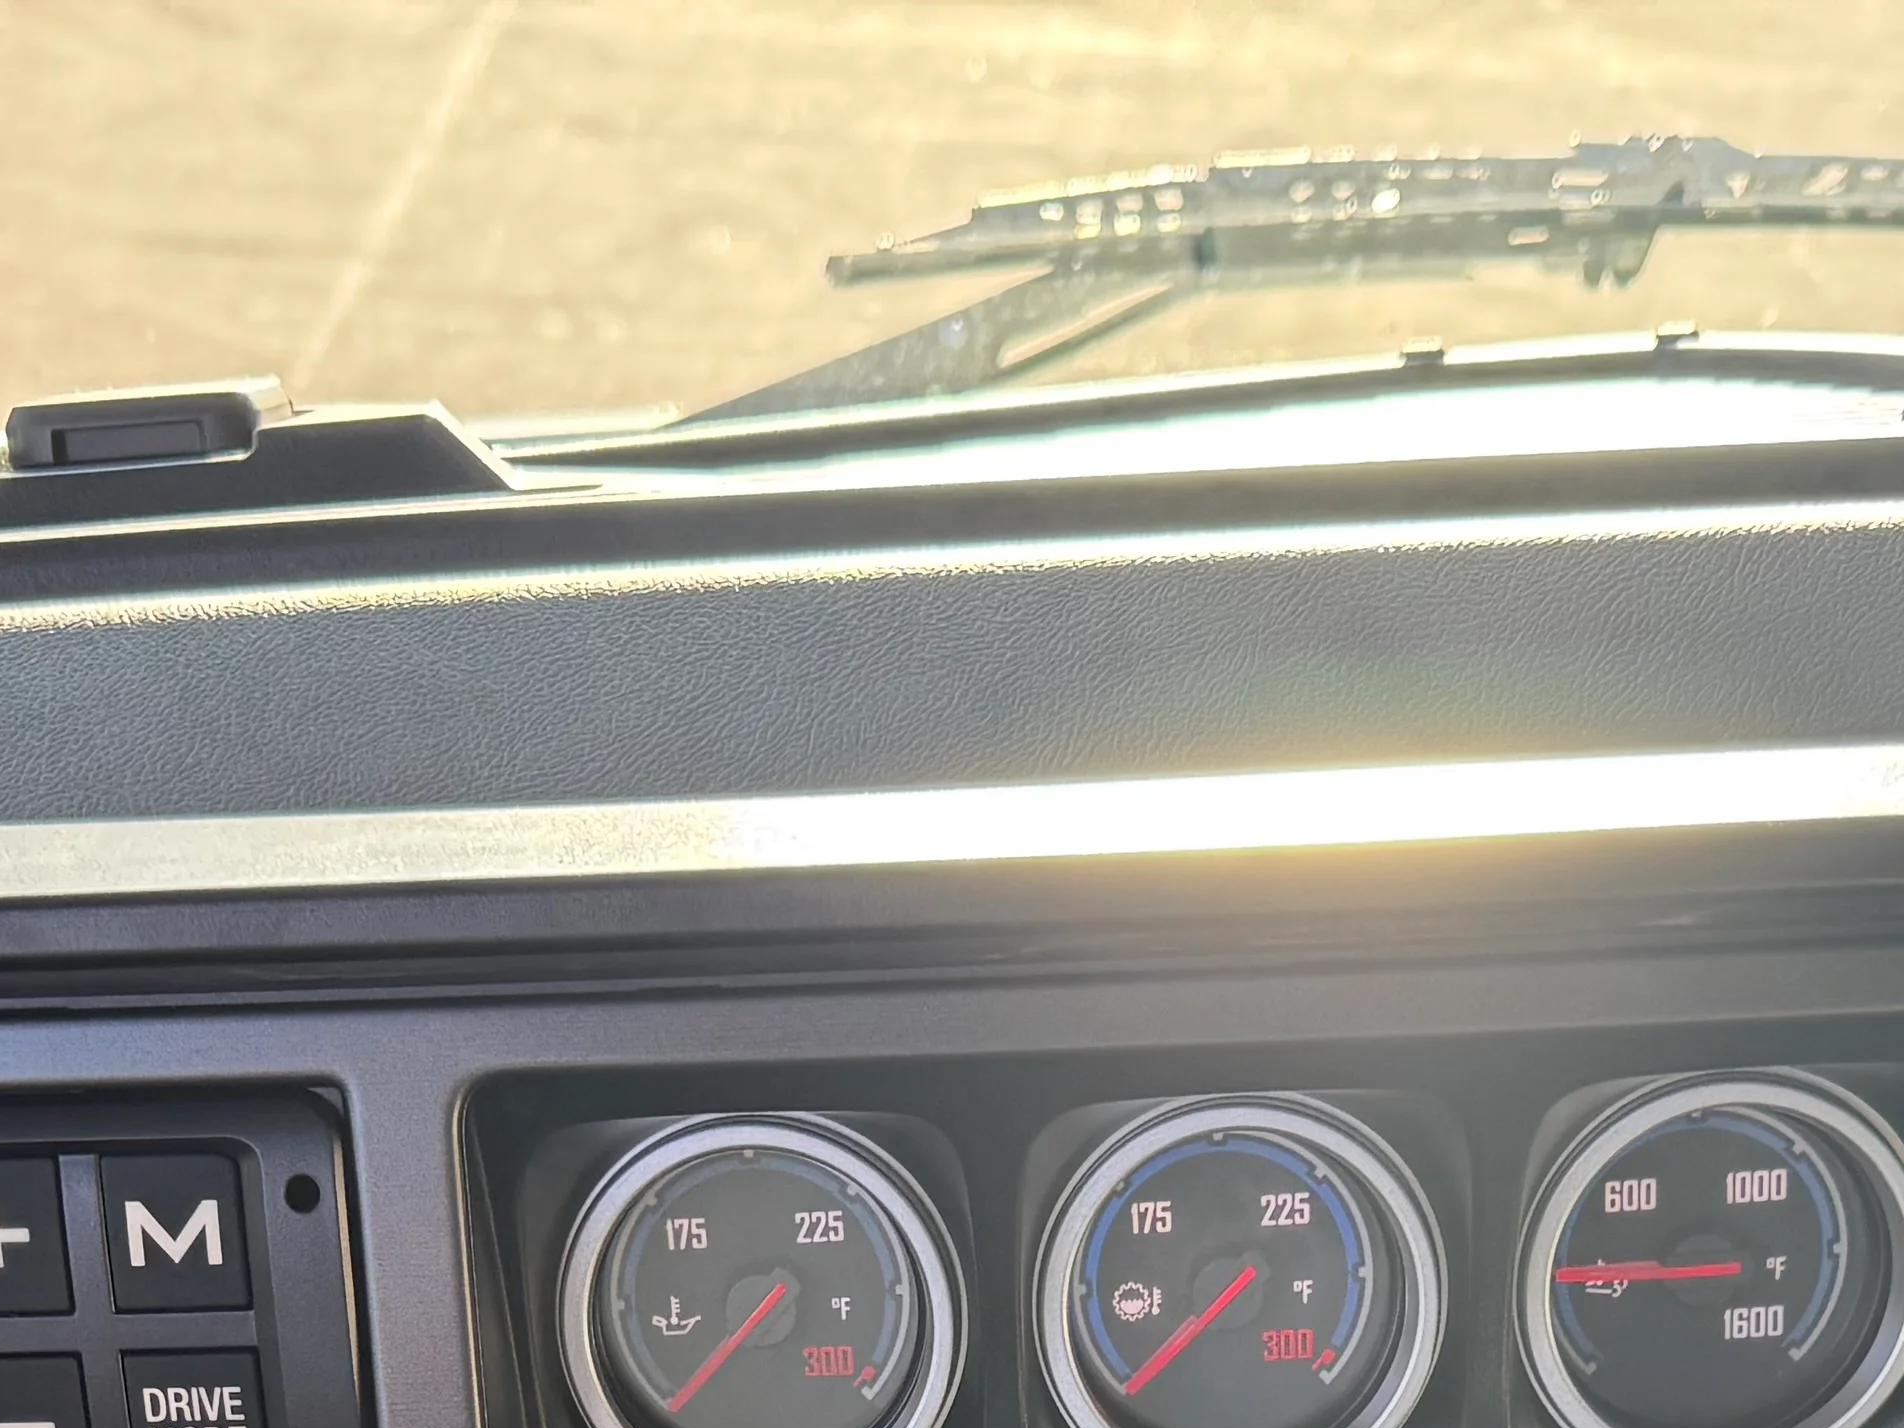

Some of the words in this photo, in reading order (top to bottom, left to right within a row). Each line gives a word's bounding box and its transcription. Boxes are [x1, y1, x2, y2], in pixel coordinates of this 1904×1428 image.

[1604, 1177, 1658, 1212] 600
[1725, 1168, 1788, 1204] 1000
[1130, 1200, 1172, 1234] 175
[1260, 1192, 1311, 1226] 225
[123, 1199, 223, 1268] M
[665, 1217, 708, 1250] 175
[795, 1210, 845, 1244] 225
[1723, 1304, 1785, 1340] 1600
[802, 1346, 855, 1376] 300
[1261, 1329, 1315, 1361] 300
[142, 1385, 246, 1424] DRIVE
